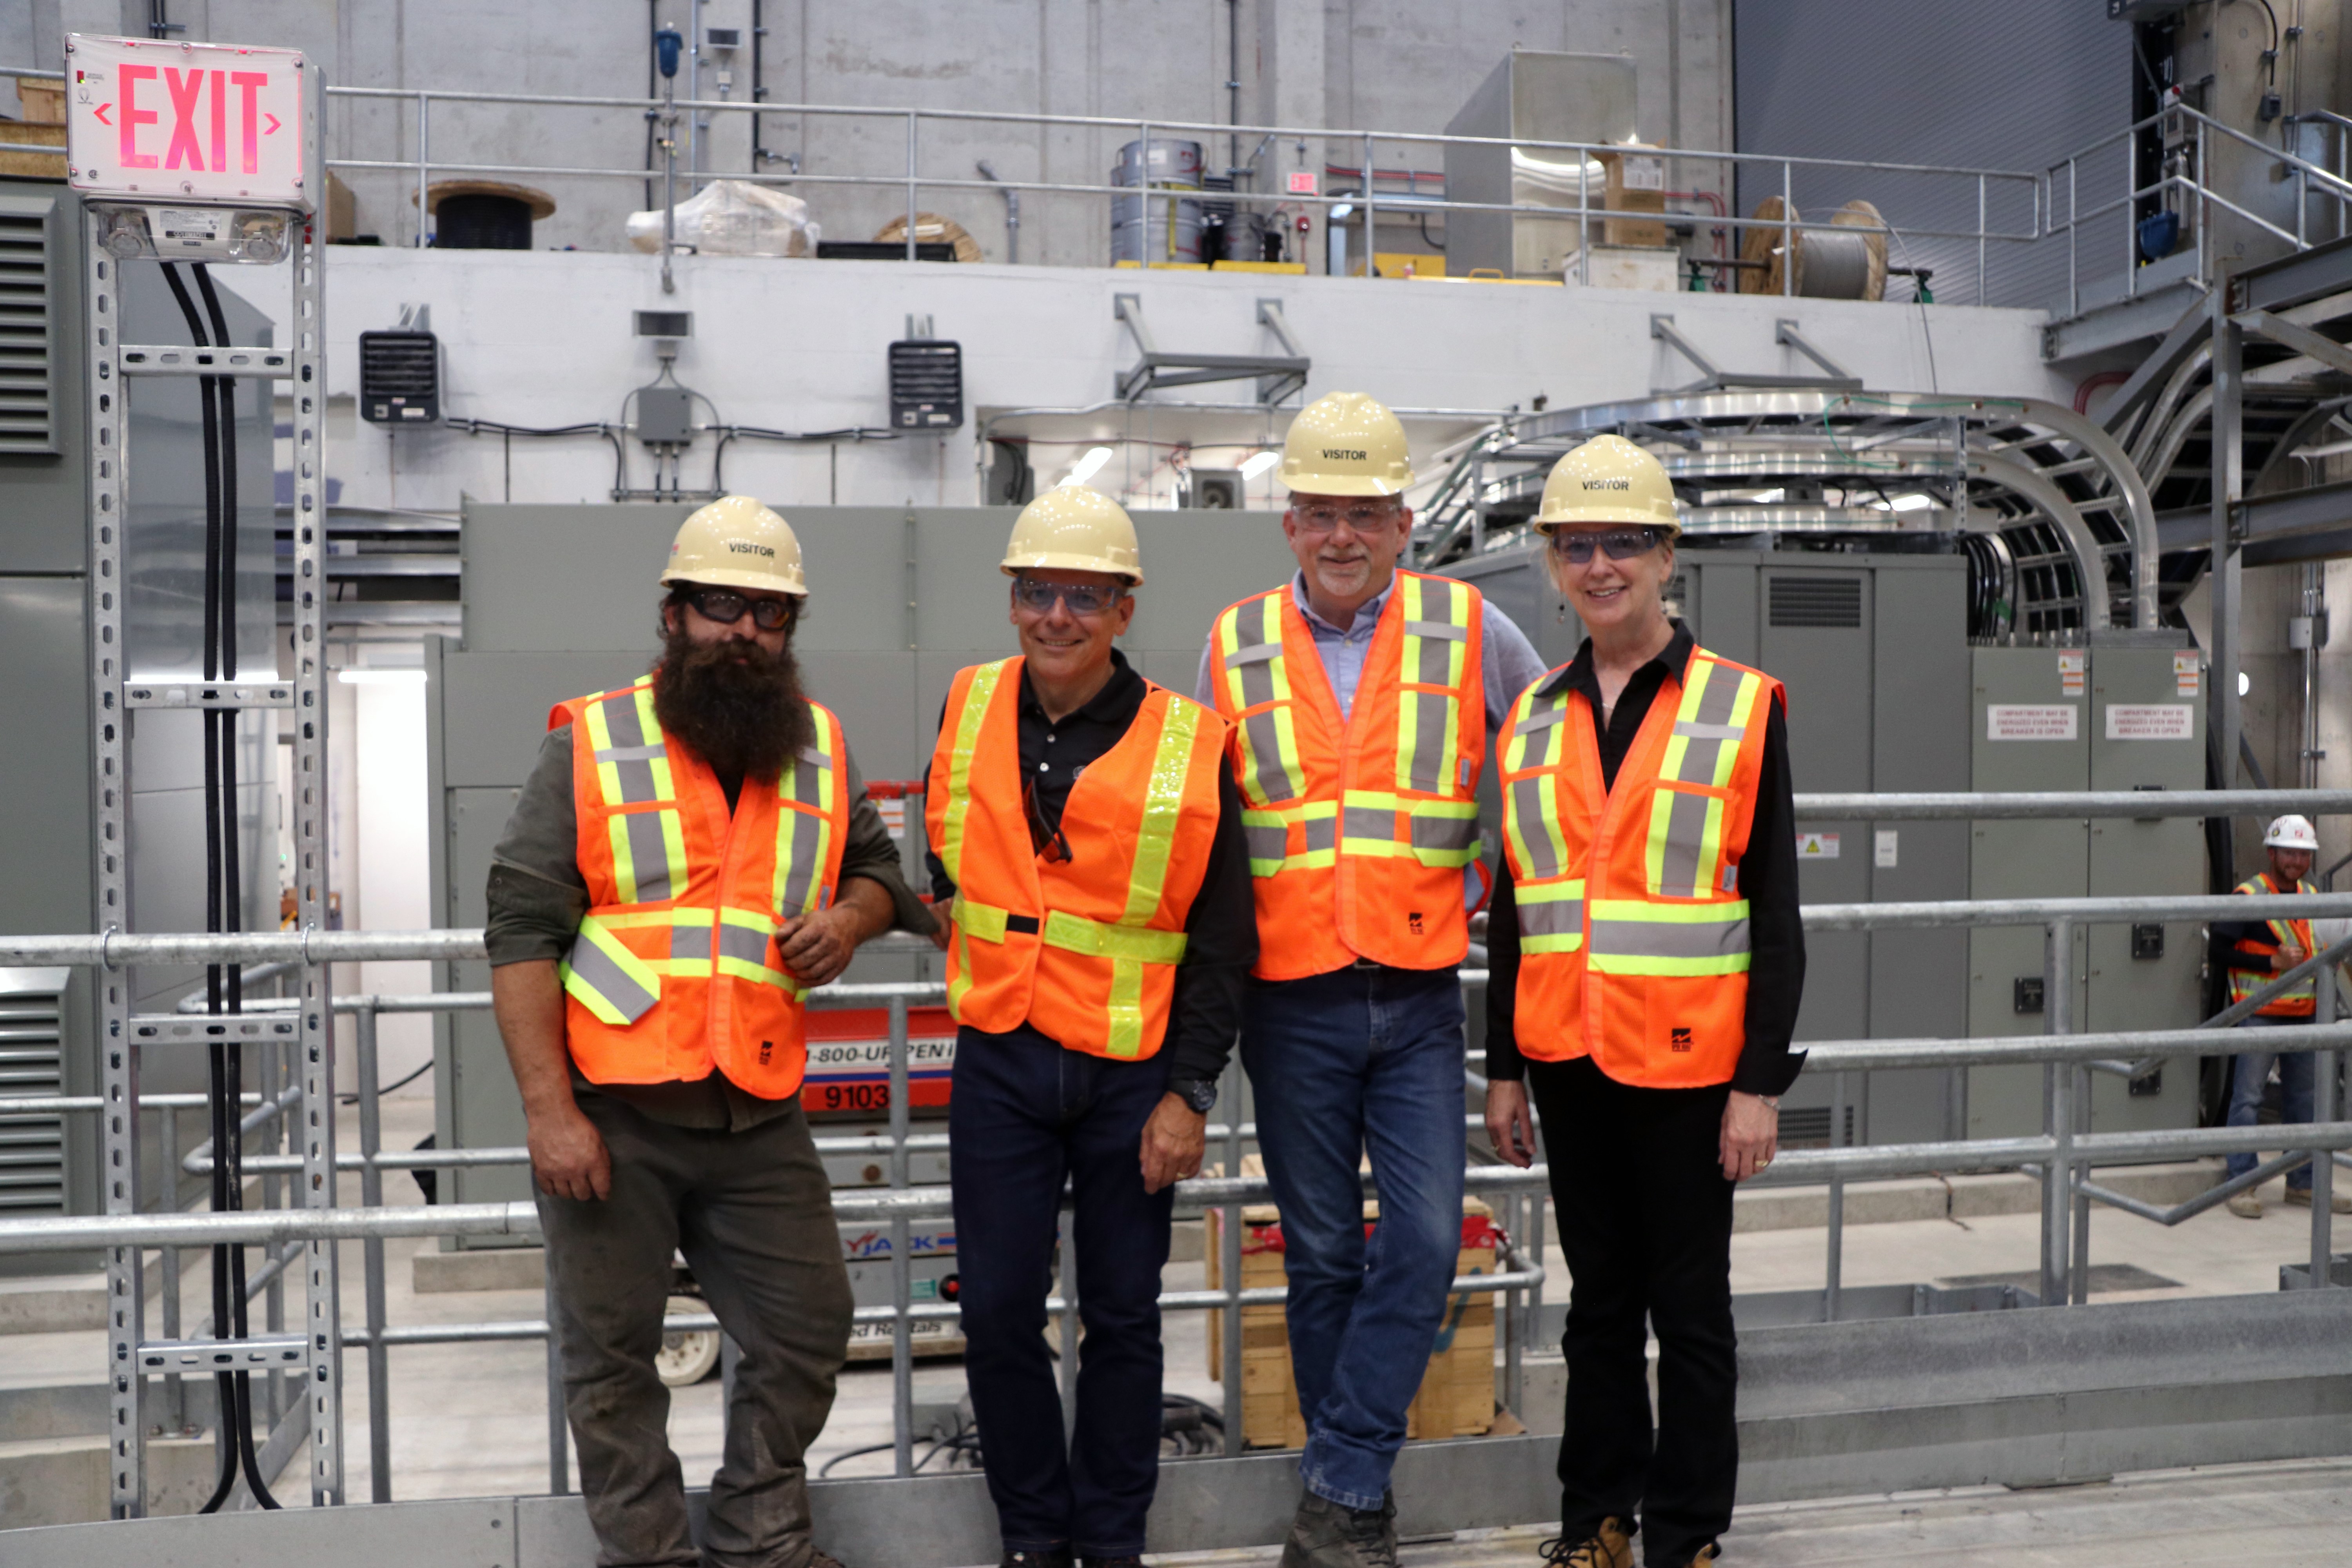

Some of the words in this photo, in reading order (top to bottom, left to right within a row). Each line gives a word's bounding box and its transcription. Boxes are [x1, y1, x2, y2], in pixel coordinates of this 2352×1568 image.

[118, 63, 268, 174] EXIT
[1323, 449, 1367, 460] VISITOR
[1582, 480, 1629, 490] VISITOR
[729, 543, 775, 558] VISITOR
[826, 1084, 889, 1109] 9103
